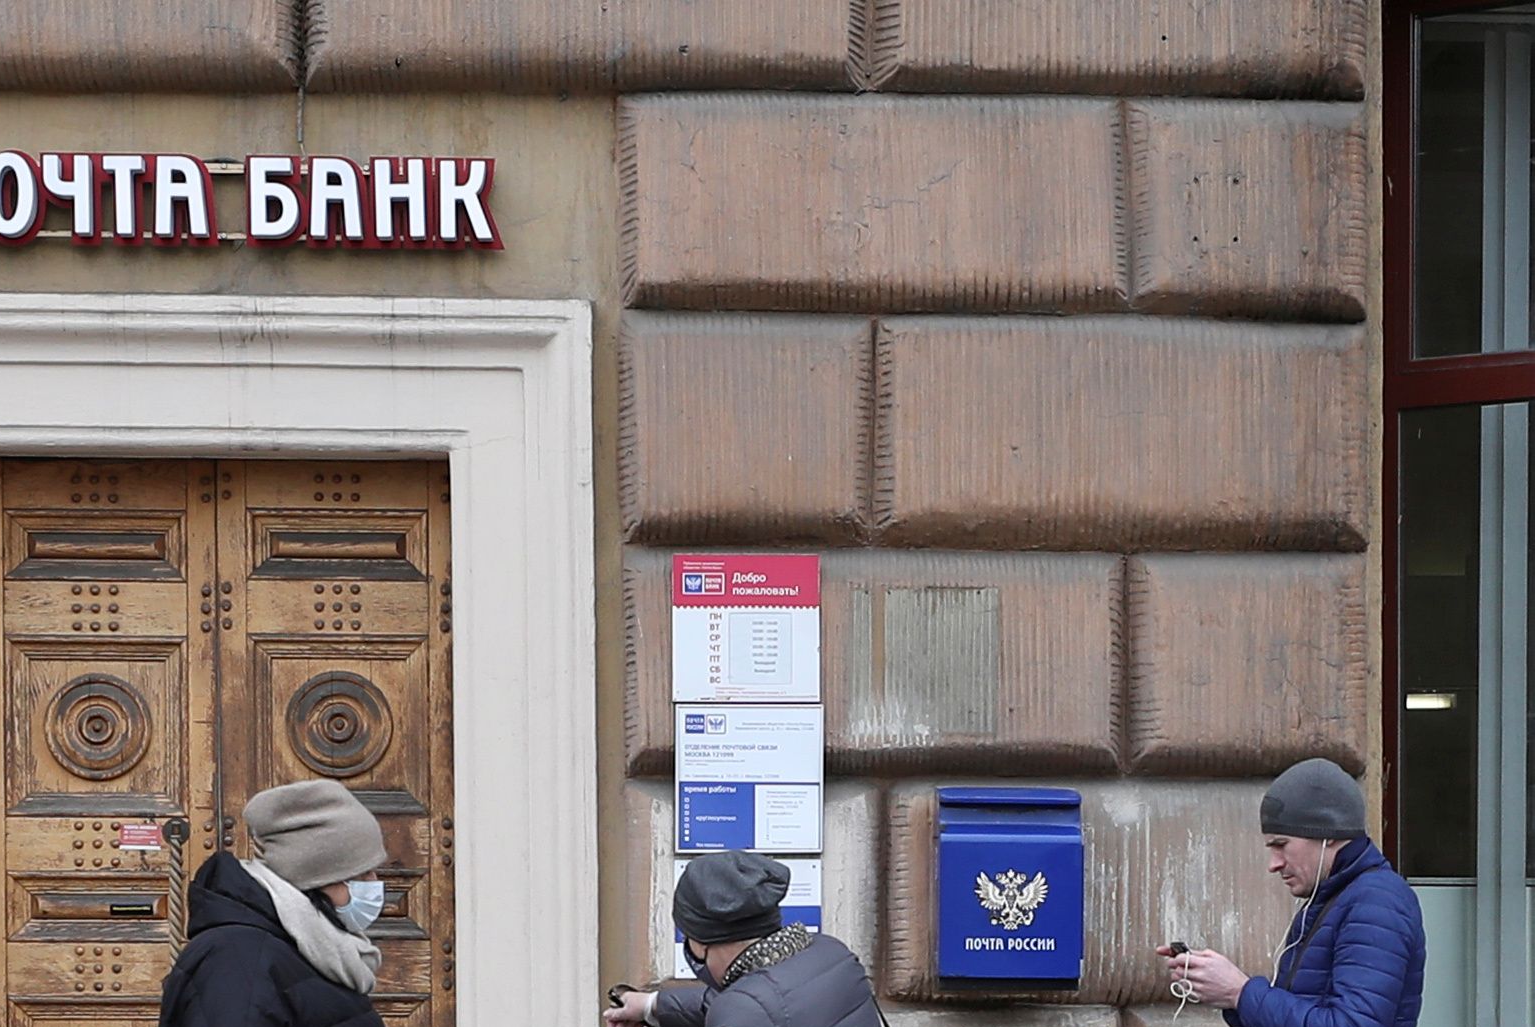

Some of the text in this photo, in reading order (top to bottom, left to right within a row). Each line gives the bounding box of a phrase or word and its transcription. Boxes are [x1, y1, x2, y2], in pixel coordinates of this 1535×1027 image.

[247, 155, 500, 248] БАНК
[732, 572, 766, 584] Добро
[732, 586, 799, 596] пожаловать!
[709, 676, 721, 684] ВС
[708, 785, 737, 794] работы
[965, 937, 1055, 951] ПОЧТА РОССИИ
